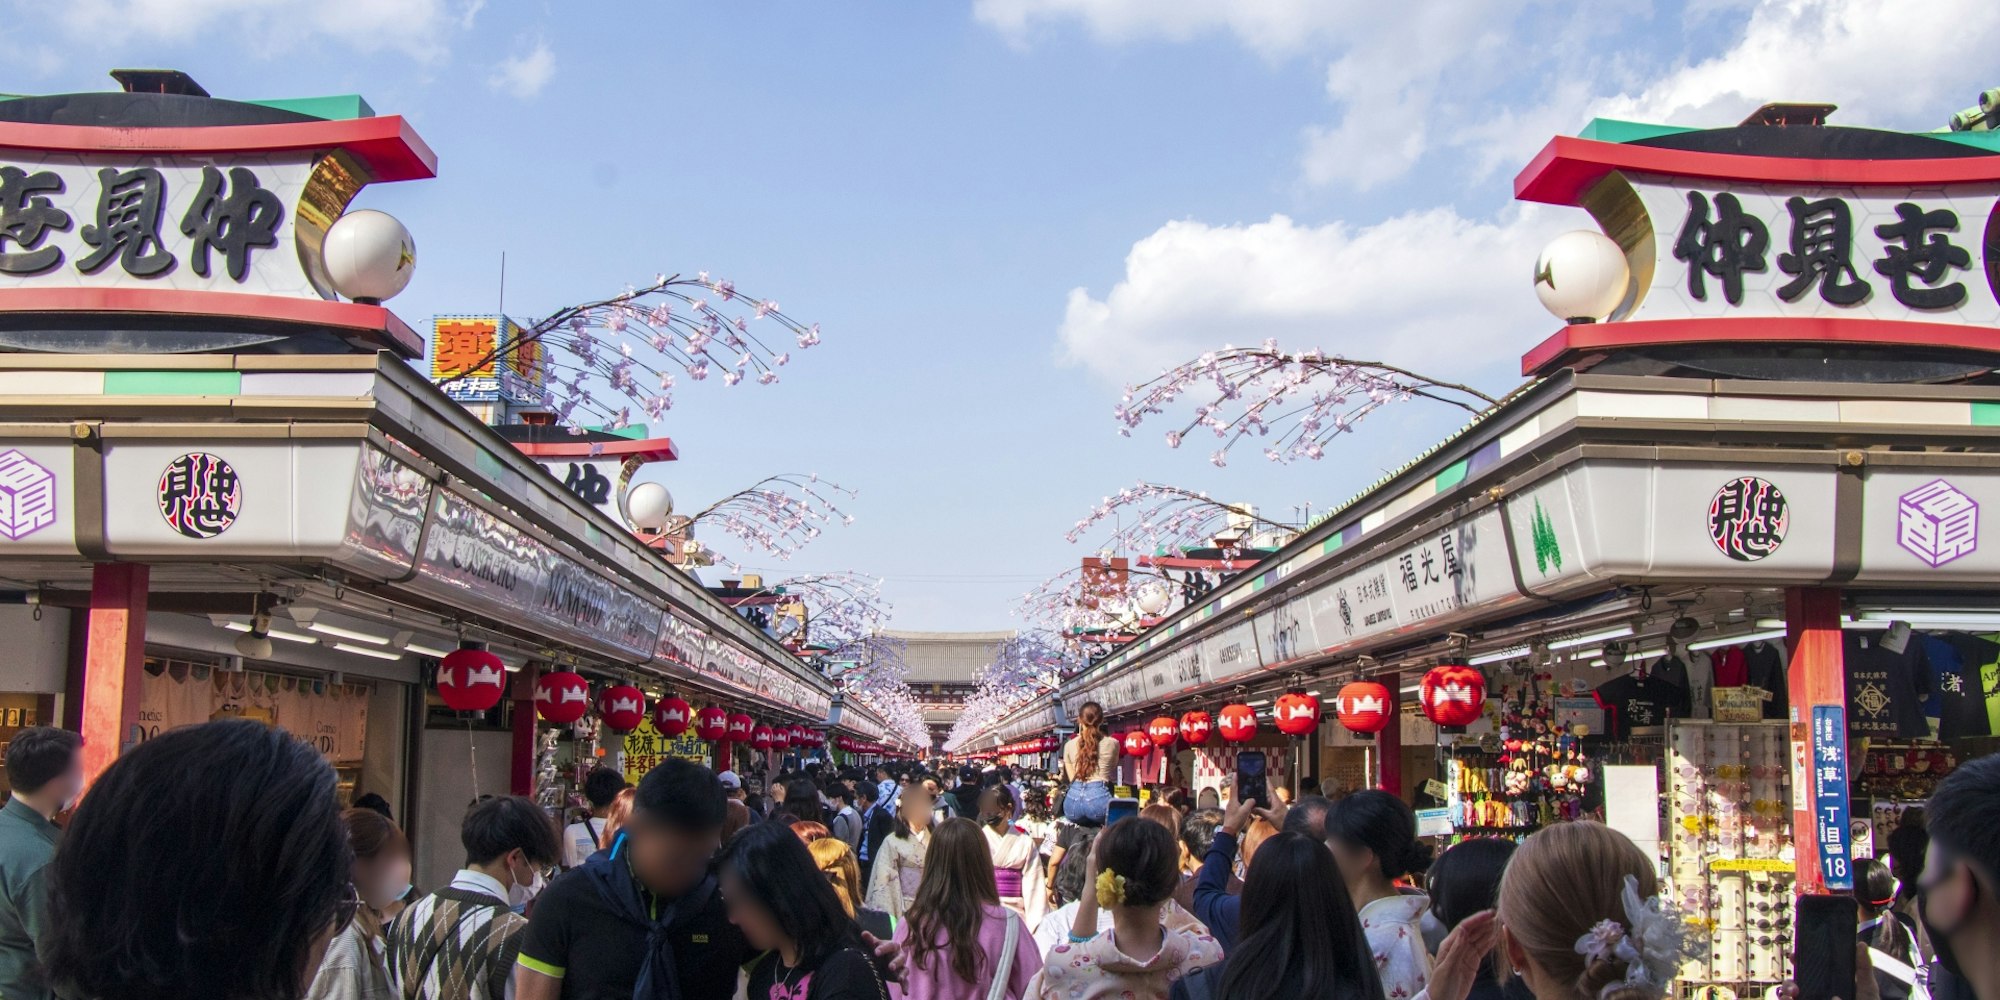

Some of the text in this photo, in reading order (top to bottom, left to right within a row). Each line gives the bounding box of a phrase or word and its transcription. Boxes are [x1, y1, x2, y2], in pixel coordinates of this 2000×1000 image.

[1674, 190, 1969, 309] 仲見世
[437, 322, 496, 373] 薬
[1400, 534, 1462, 593] 福光屋
[1822, 746, 1840, 843] 浅草一丁目
[1825, 858, 1846, 877] 18
